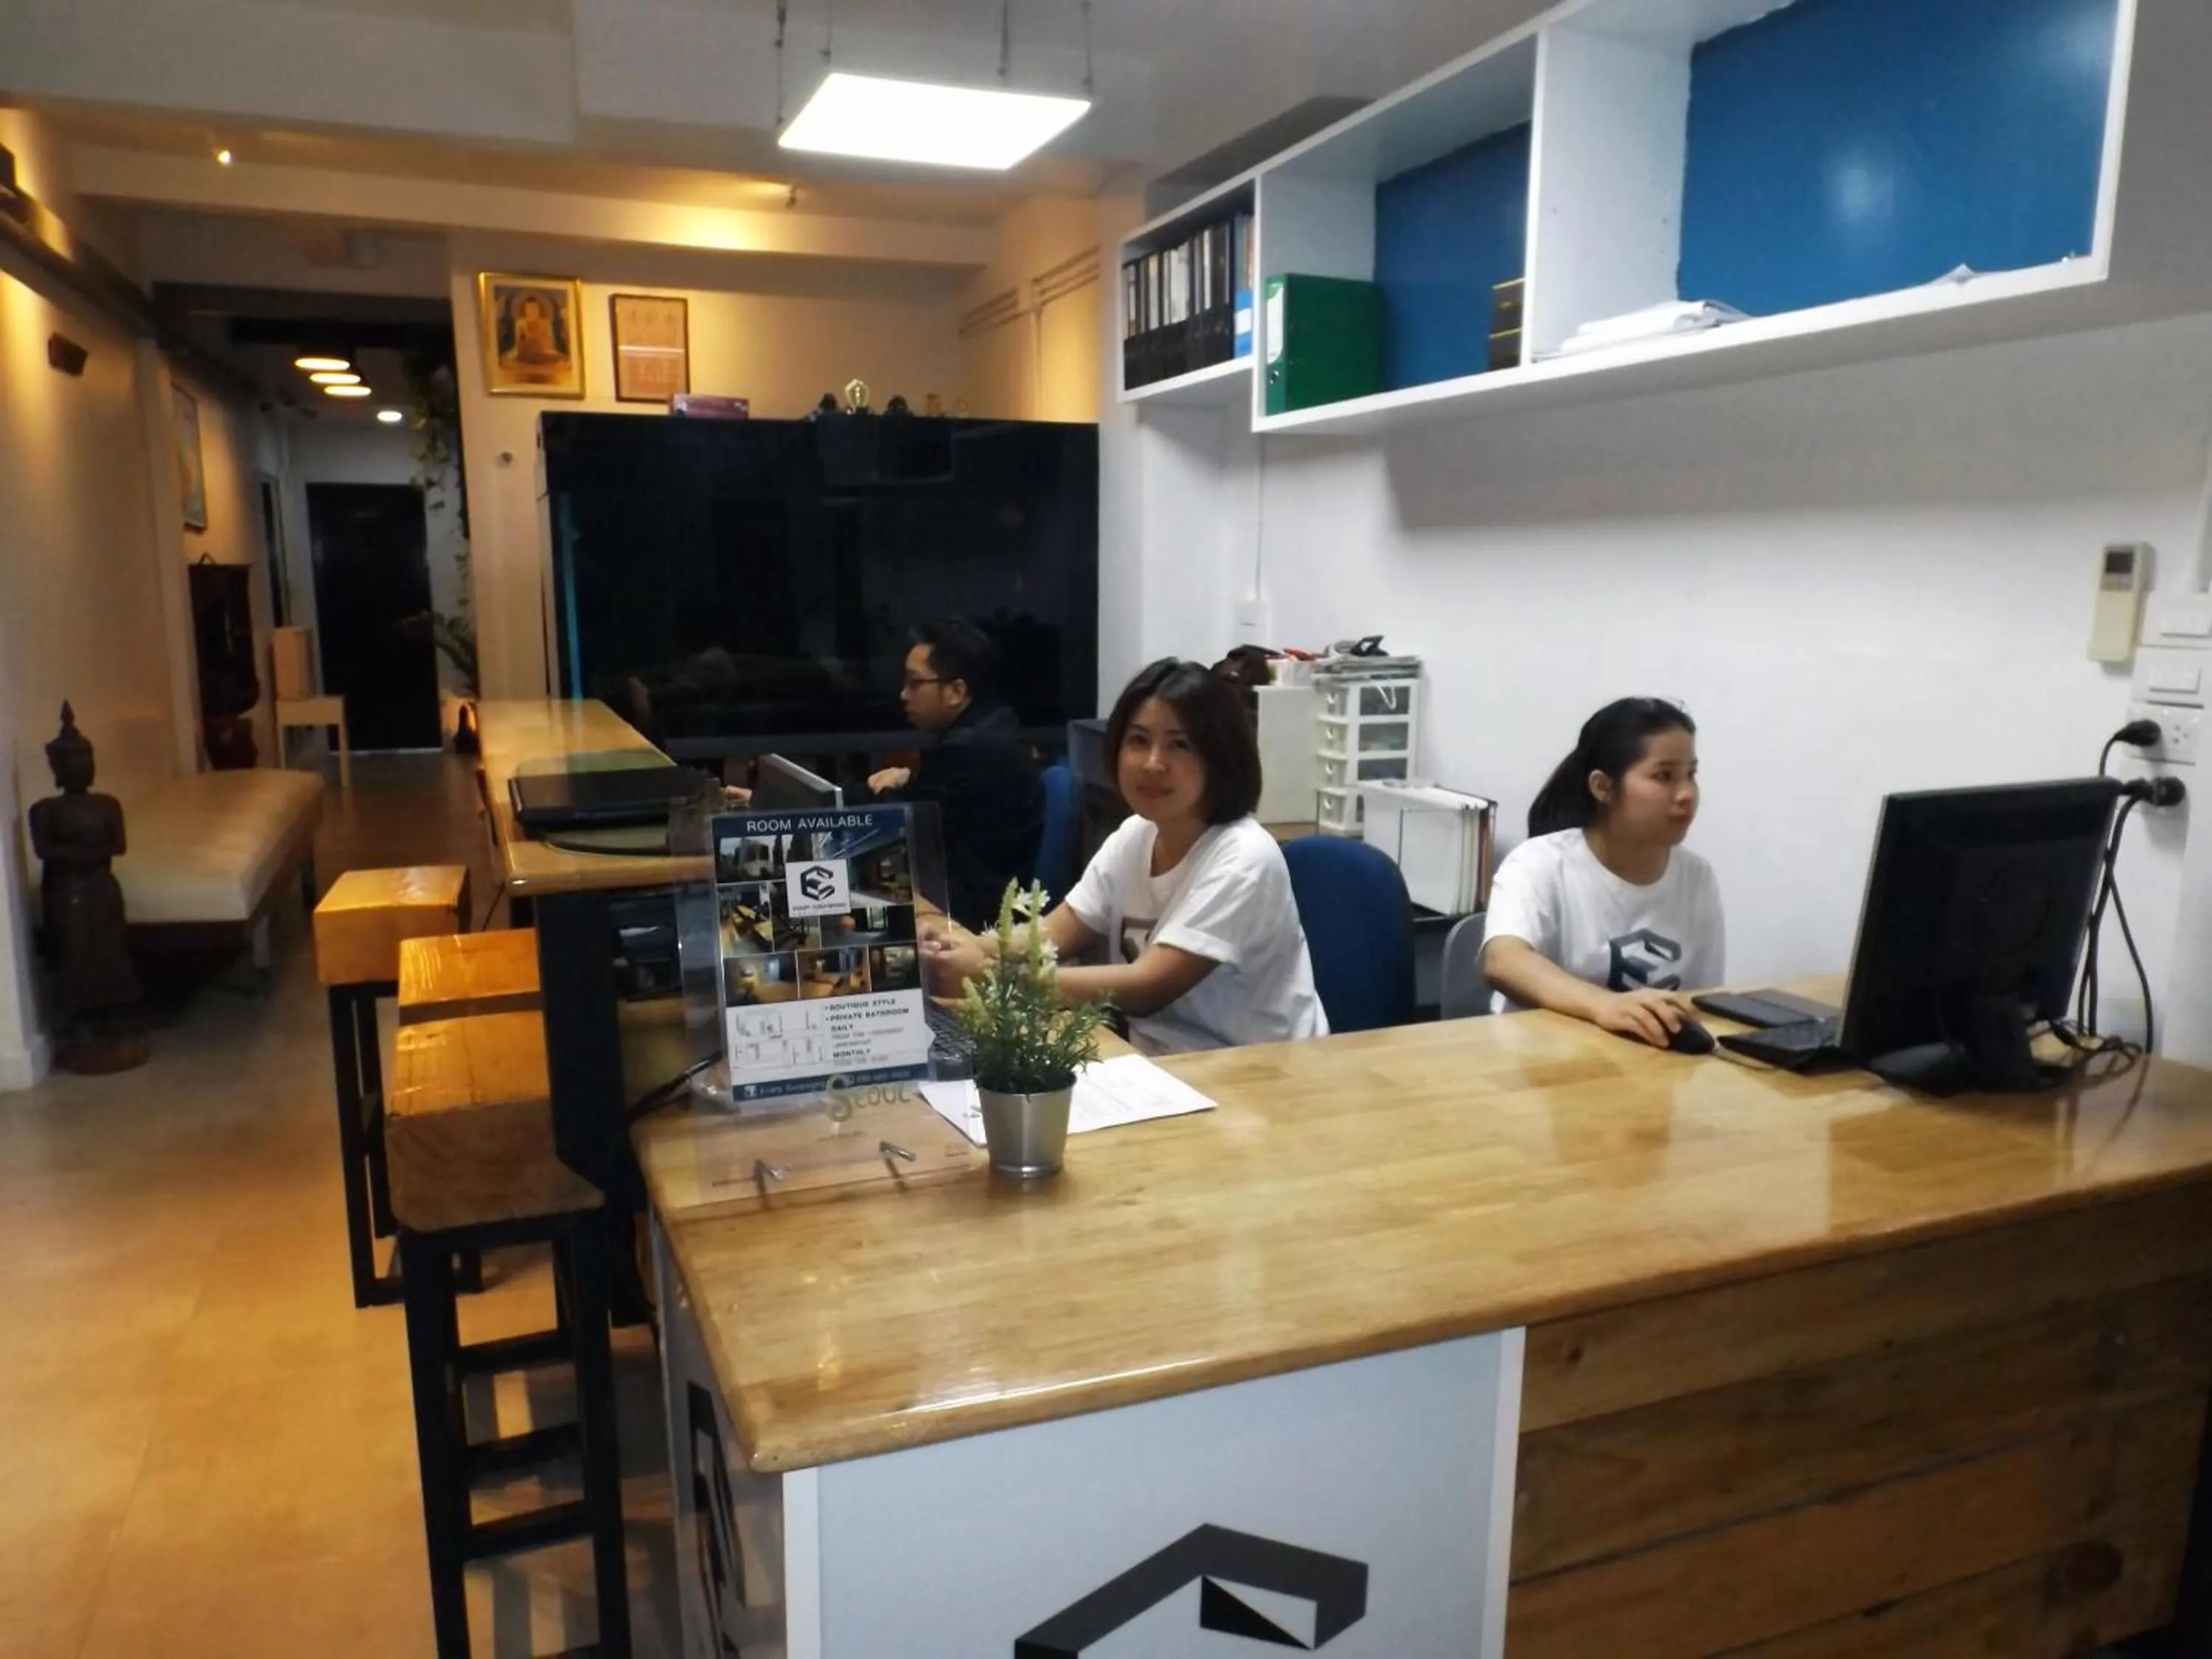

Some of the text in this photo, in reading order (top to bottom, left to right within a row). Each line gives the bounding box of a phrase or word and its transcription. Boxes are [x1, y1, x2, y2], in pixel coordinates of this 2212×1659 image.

[747, 813, 873, 832] ROOM AVAILABLE
[830, 1007, 909, 1021] PRIVATE BATHROOM
